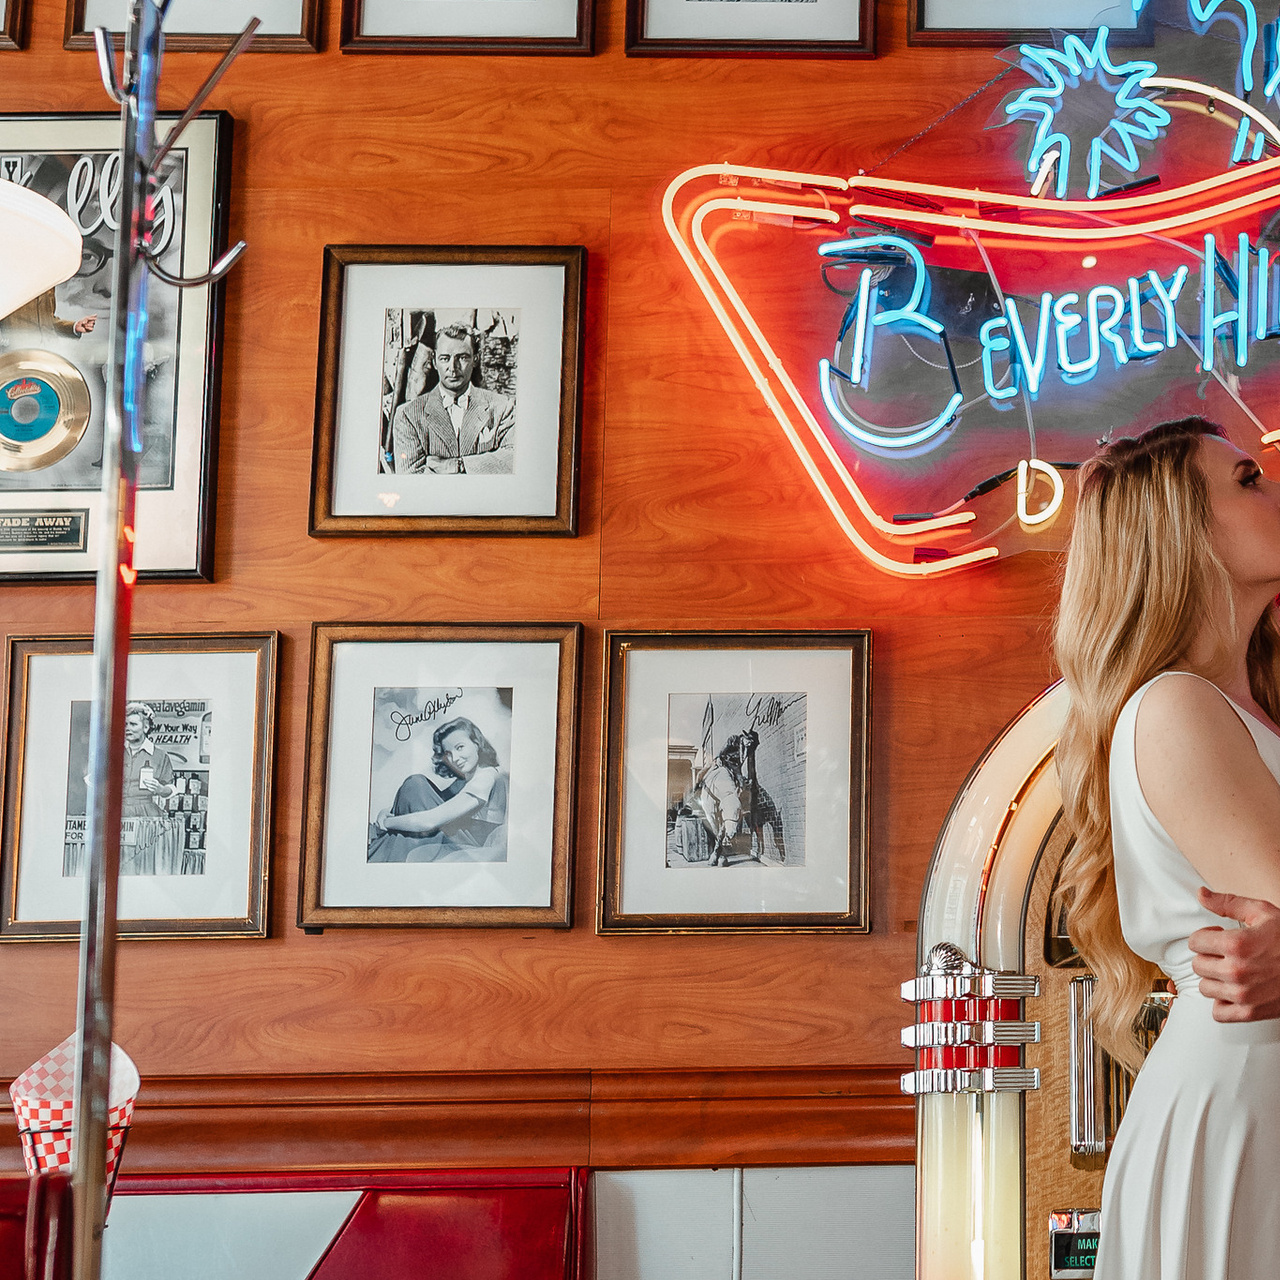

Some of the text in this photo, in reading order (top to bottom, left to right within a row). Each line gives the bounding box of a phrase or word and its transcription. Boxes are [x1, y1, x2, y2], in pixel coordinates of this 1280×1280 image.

[35, 517, 73, 527] AWAY
[155, 734, 191, 744] HEALTH
[65, 831, 84, 840] FOR
[1077, 1238, 1099, 1250] MAK
